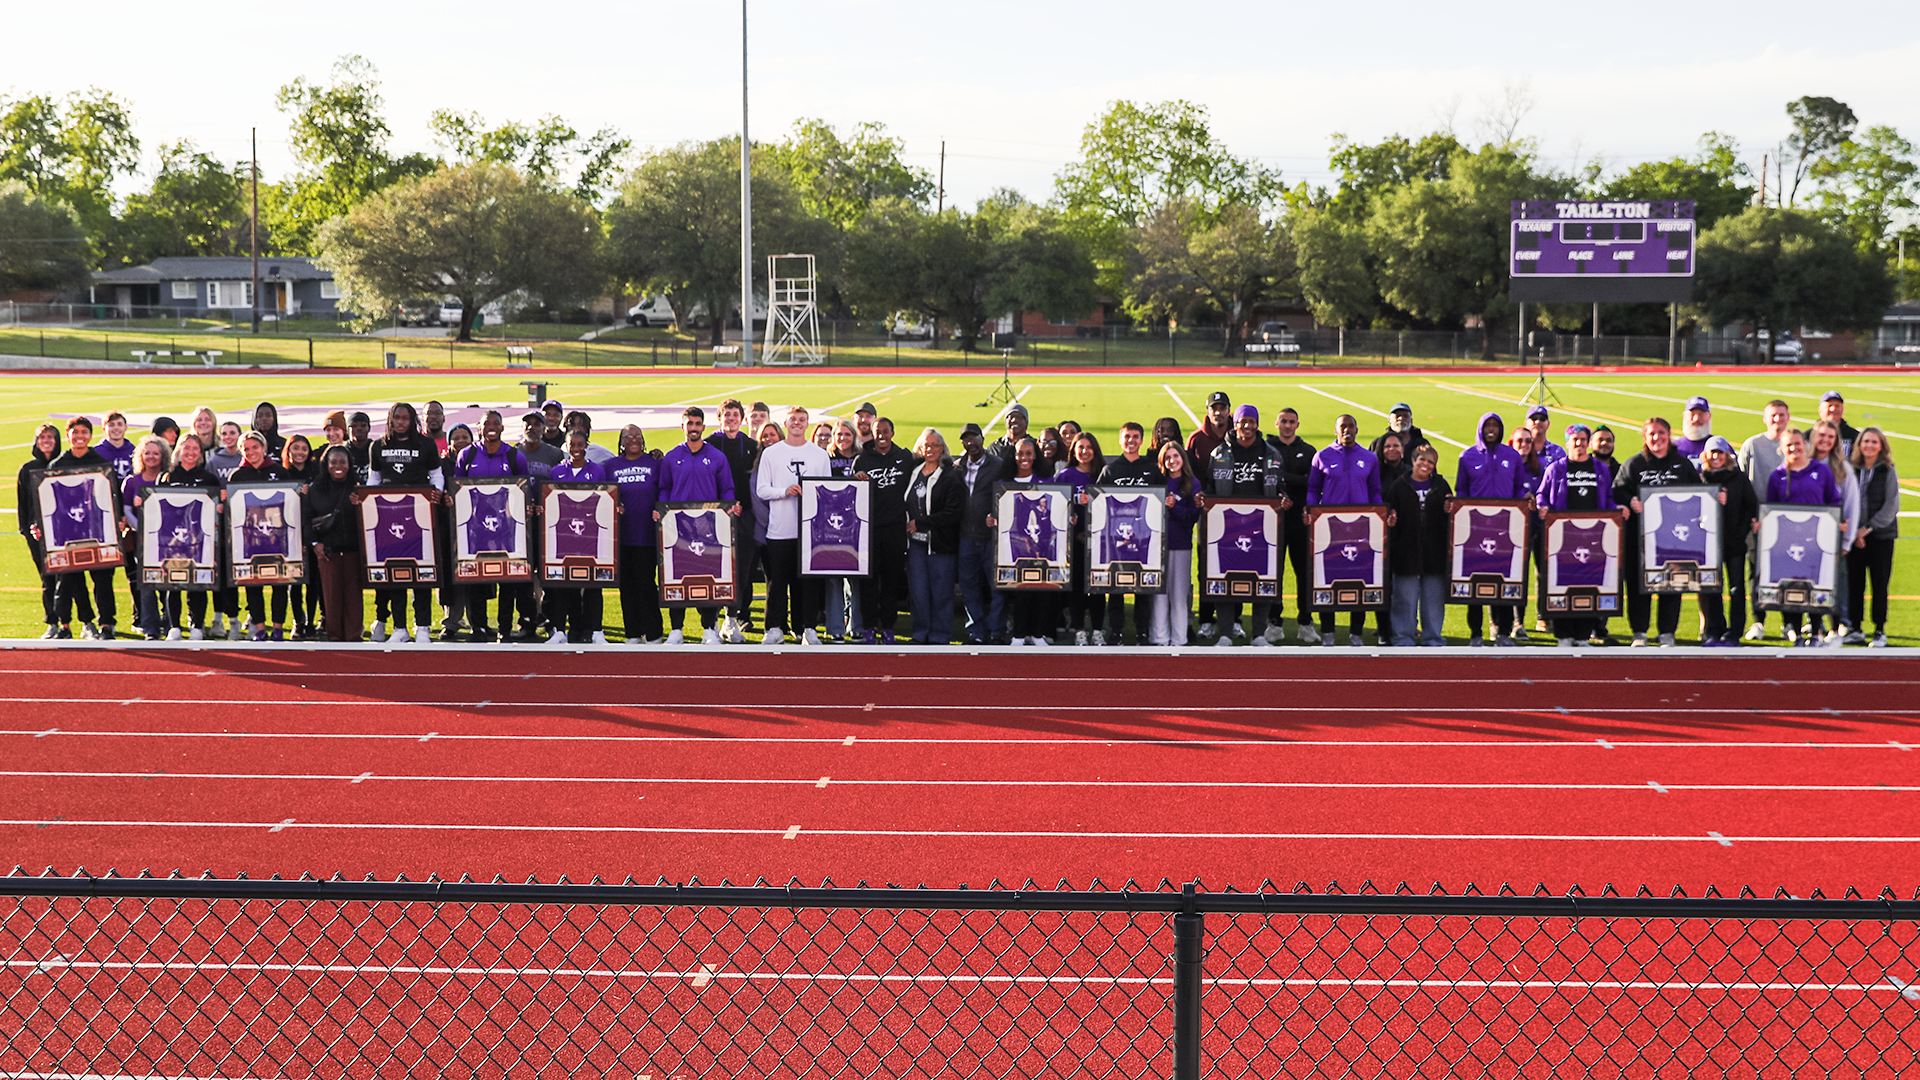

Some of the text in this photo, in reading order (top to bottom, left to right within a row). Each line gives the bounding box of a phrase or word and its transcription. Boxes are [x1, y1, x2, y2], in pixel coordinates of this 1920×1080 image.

[1555, 203, 1650, 218] TARLETON
[1518, 222, 1553, 232] TEXANS
[1657, 221, 1690, 231] VISITOR
[1515, 251, 1541, 260] EVENT
[1568, 251, 1594, 260] PLACE
[1613, 251, 1635, 260] LANE
[1666, 250, 1688, 260] HEAT
[381, 449, 410, 457] GREATER
[613, 466, 652, 477] TARLETON
[618, 475, 646, 483] MOM
